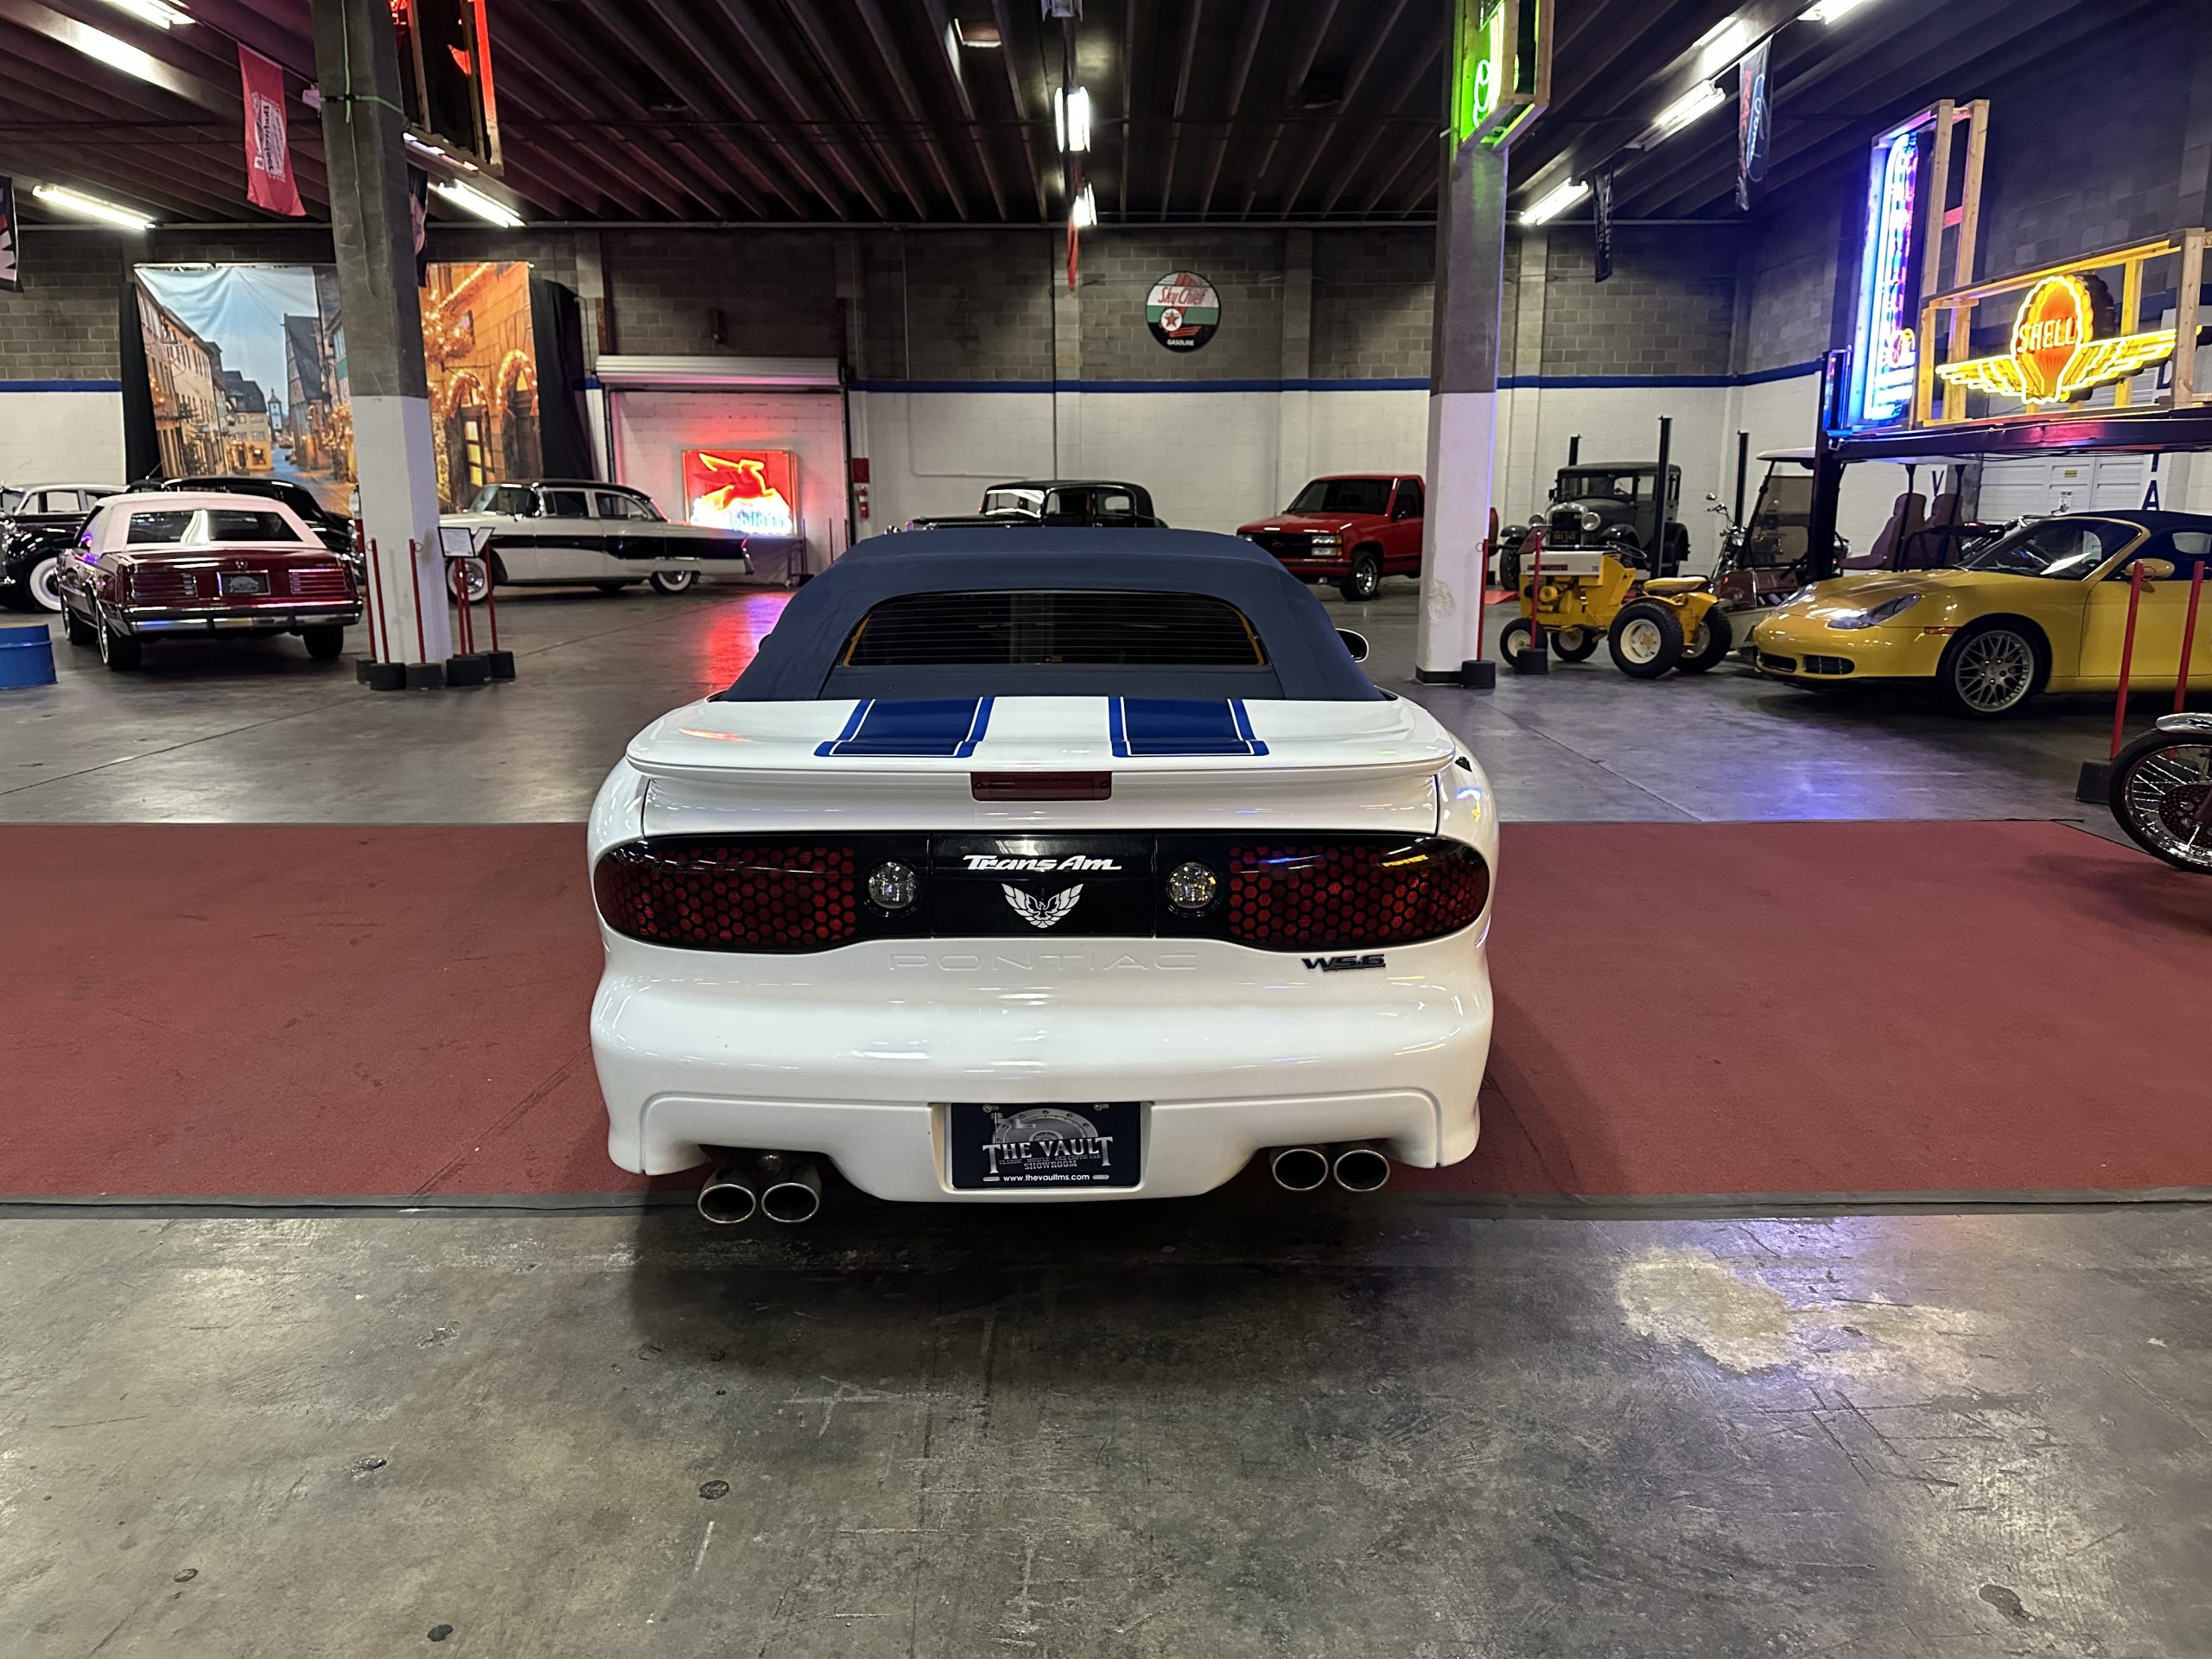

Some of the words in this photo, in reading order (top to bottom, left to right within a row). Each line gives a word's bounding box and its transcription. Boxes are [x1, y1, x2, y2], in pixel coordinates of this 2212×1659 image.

[1158, 286, 1177, 305] Sky
[1178, 287, 1208, 305] Chief
[2016, 316, 2076, 353] SHELL
[962, 855, 1052, 871] Trans
[1054, 855, 1122, 871] Am
[888, 953, 1198, 971] PONTIAC
[982, 1141, 1033, 1174] THE
[1039, 1136, 1114, 1166] VAULT
[1023, 1160, 1077, 1170] SHOWROOM
[1002, 1173, 1090, 1182] www.thevaultms.com
